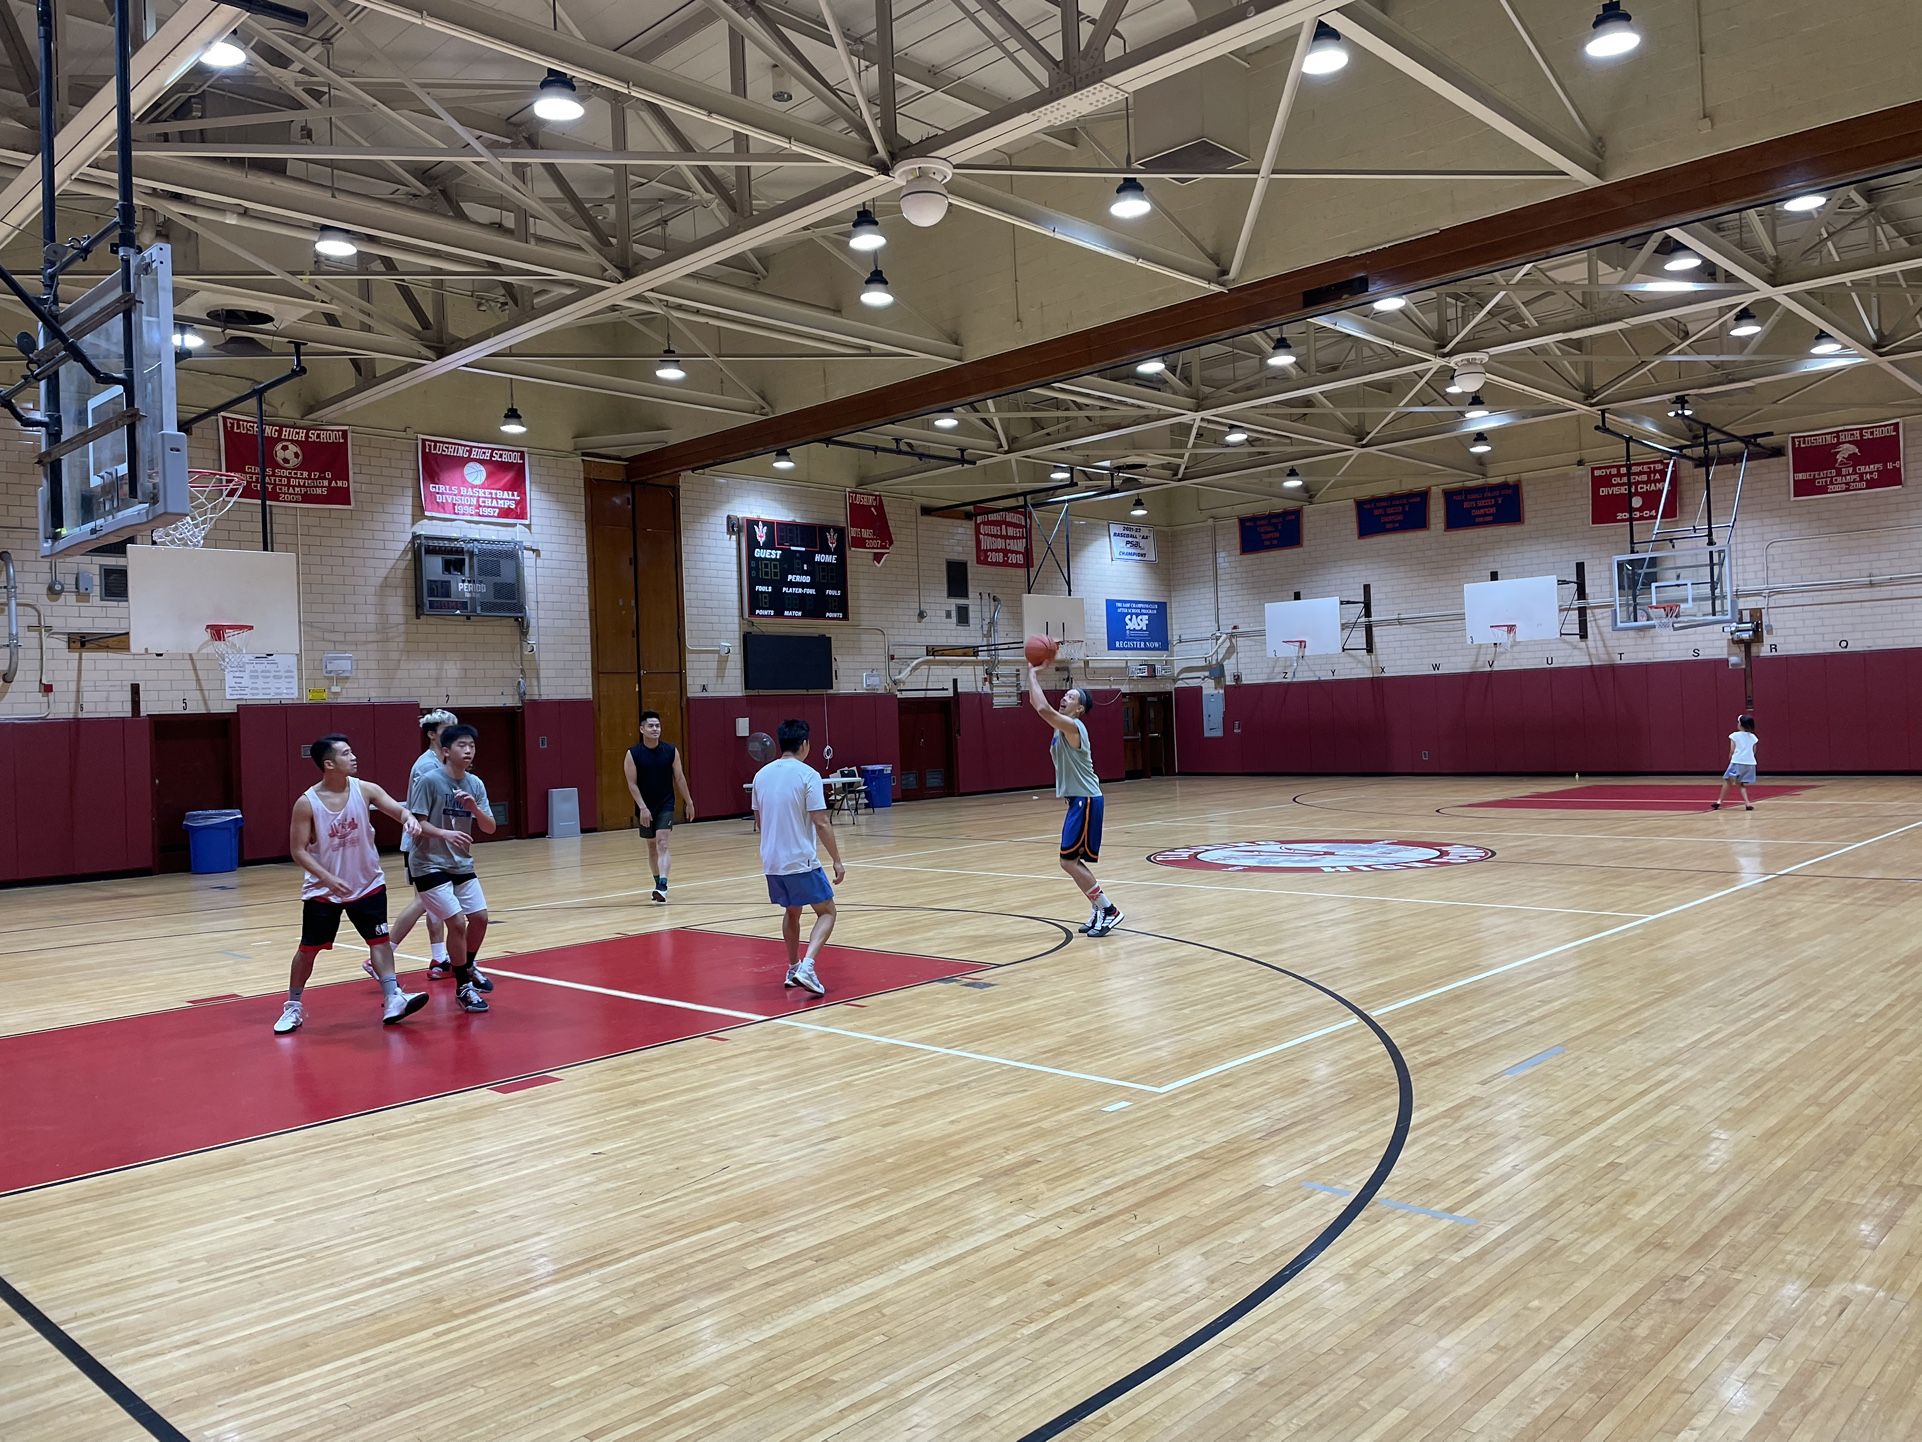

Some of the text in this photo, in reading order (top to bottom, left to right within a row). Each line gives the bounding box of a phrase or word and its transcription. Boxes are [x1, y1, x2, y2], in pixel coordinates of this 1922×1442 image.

[282, 427, 305, 441] HIGH
[309, 431, 344, 443] SCHOOL
[1795, 426, 1896, 447] FLUSHING HIGH SCHOOL
[425, 441, 523, 463] FLUSHING HIGH SCHOOL
[275, 468, 308, 478] SOCCER
[1594, 468, 1617, 476] BOYS
[1794, 469, 1836, 480] UNDEFEATED
[1856, 463, 1883, 472] CHAMPS
[290, 478, 329, 487] DIVISION
[1833, 474, 1860, 484] CHAMPS
[276, 486, 327, 495] CHAMPIONS
[430, 484, 520, 499] GIRLS BASKETBALL
[436, 494, 515, 508] DIVISION CHAMPS
[754, 548, 782, 559] GUEST
[815, 554, 837, 563] HOME
[787, 574, 810, 582] PERIOD
[458, 583, 486, 592] PERIOD
[1125, 614, 1148, 630] SASF
[1770, 644, 1777, 653] R
[1839, 640, 1849, 649] Q
[1618, 652, 1624, 660] T
[1692, 648, 1700, 657] S
[1546, 657, 1553, 665] U
[1432, 663, 1440, 671] W
[701, 684, 707, 692] A
[182, 698, 188, 711] 5
